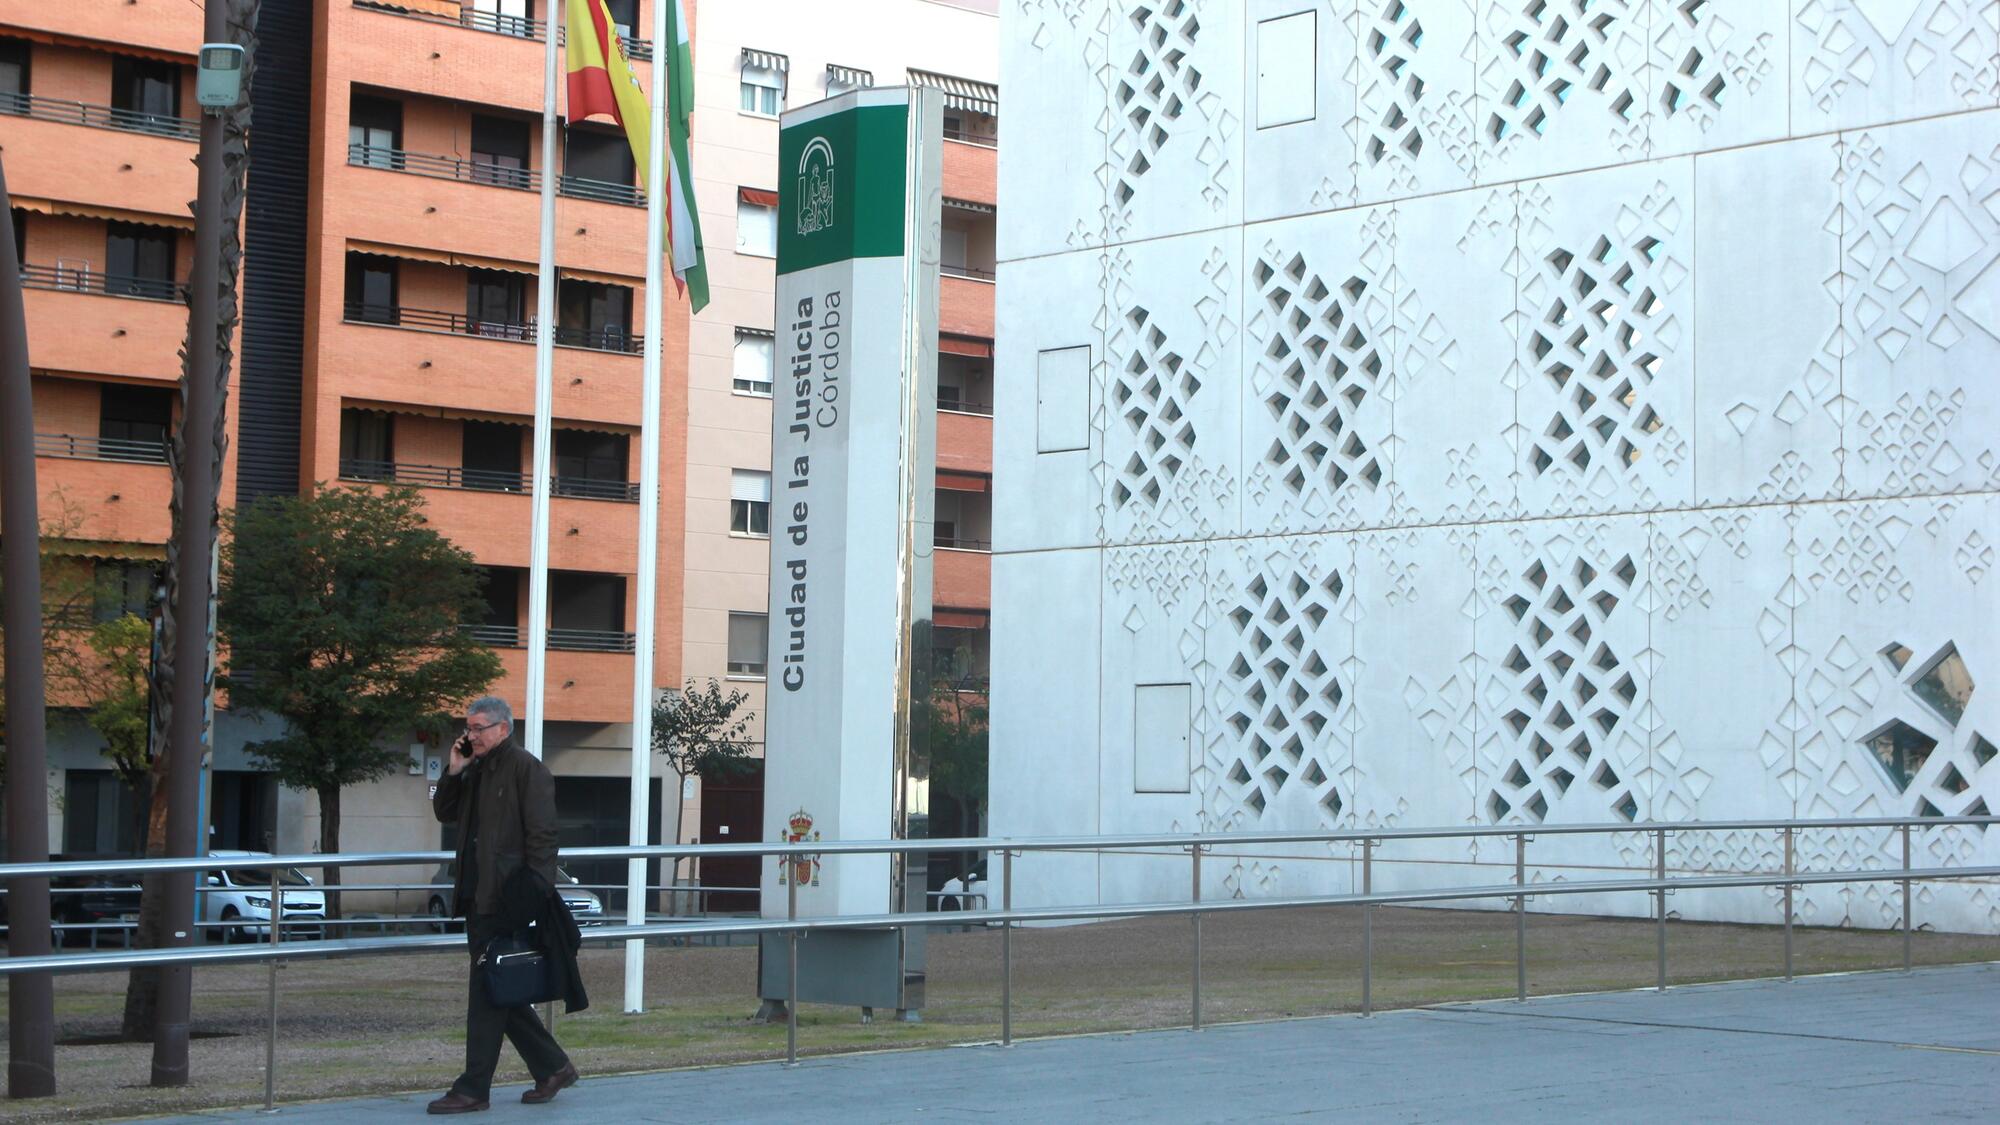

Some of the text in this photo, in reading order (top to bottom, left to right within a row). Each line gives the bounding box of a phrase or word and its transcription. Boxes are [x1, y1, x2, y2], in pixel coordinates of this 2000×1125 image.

[816, 291, 841, 429] Córdoba
[783, 297, 813, 692] Ciudad de la Justicia
